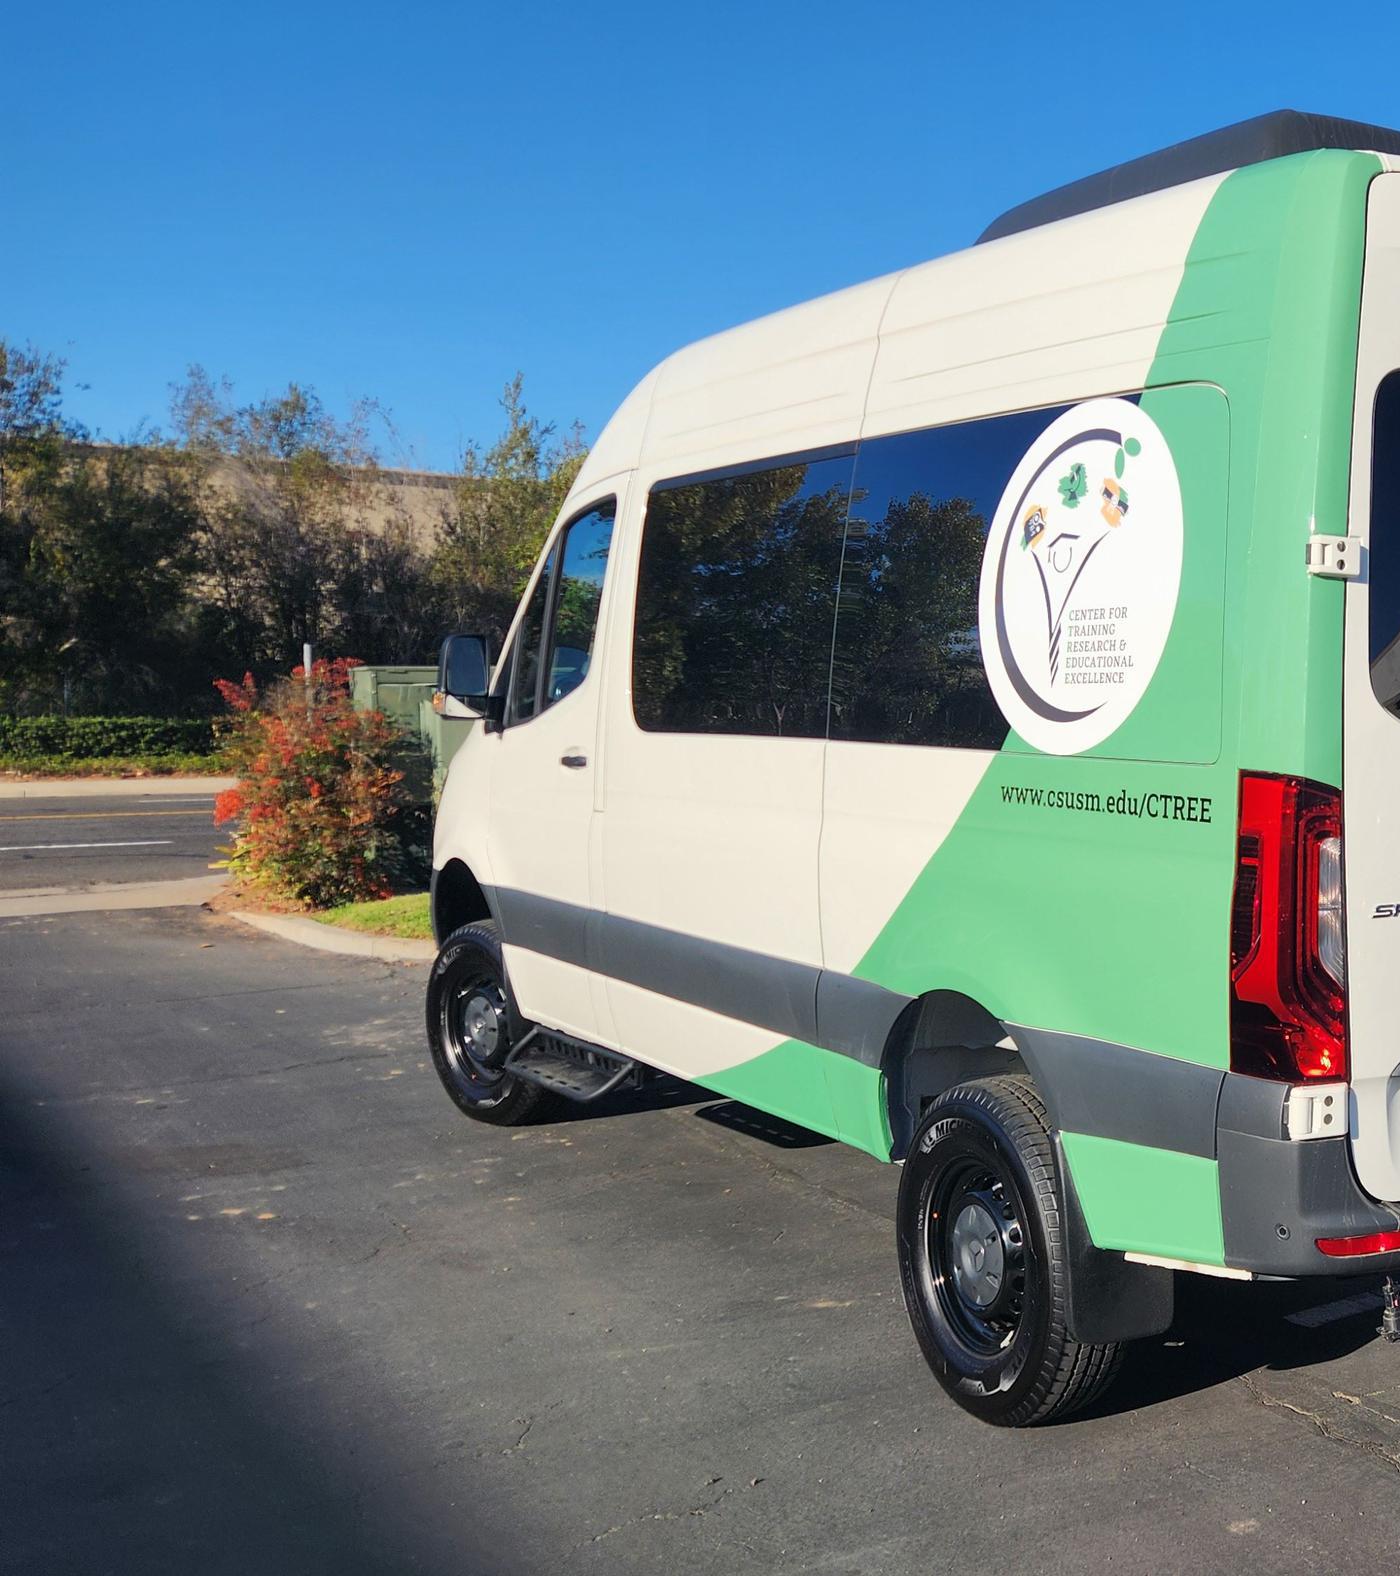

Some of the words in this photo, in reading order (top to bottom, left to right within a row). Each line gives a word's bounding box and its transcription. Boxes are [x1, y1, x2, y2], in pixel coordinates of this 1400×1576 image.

[1068, 607, 1106, 621] CENTER
[1108, 606, 1128, 620] FOR
[1067, 623, 1116, 637] TRAINING
[1066, 639, 1117, 653] RESEARCH
[1119, 639, 1128, 652] &
[1065, 655, 1134, 669] EDUCATIONAL
[1064, 671, 1125, 684] EXCELLENCE
[1001, 785, 1212, 823] www.csusm.edu/CTREE
